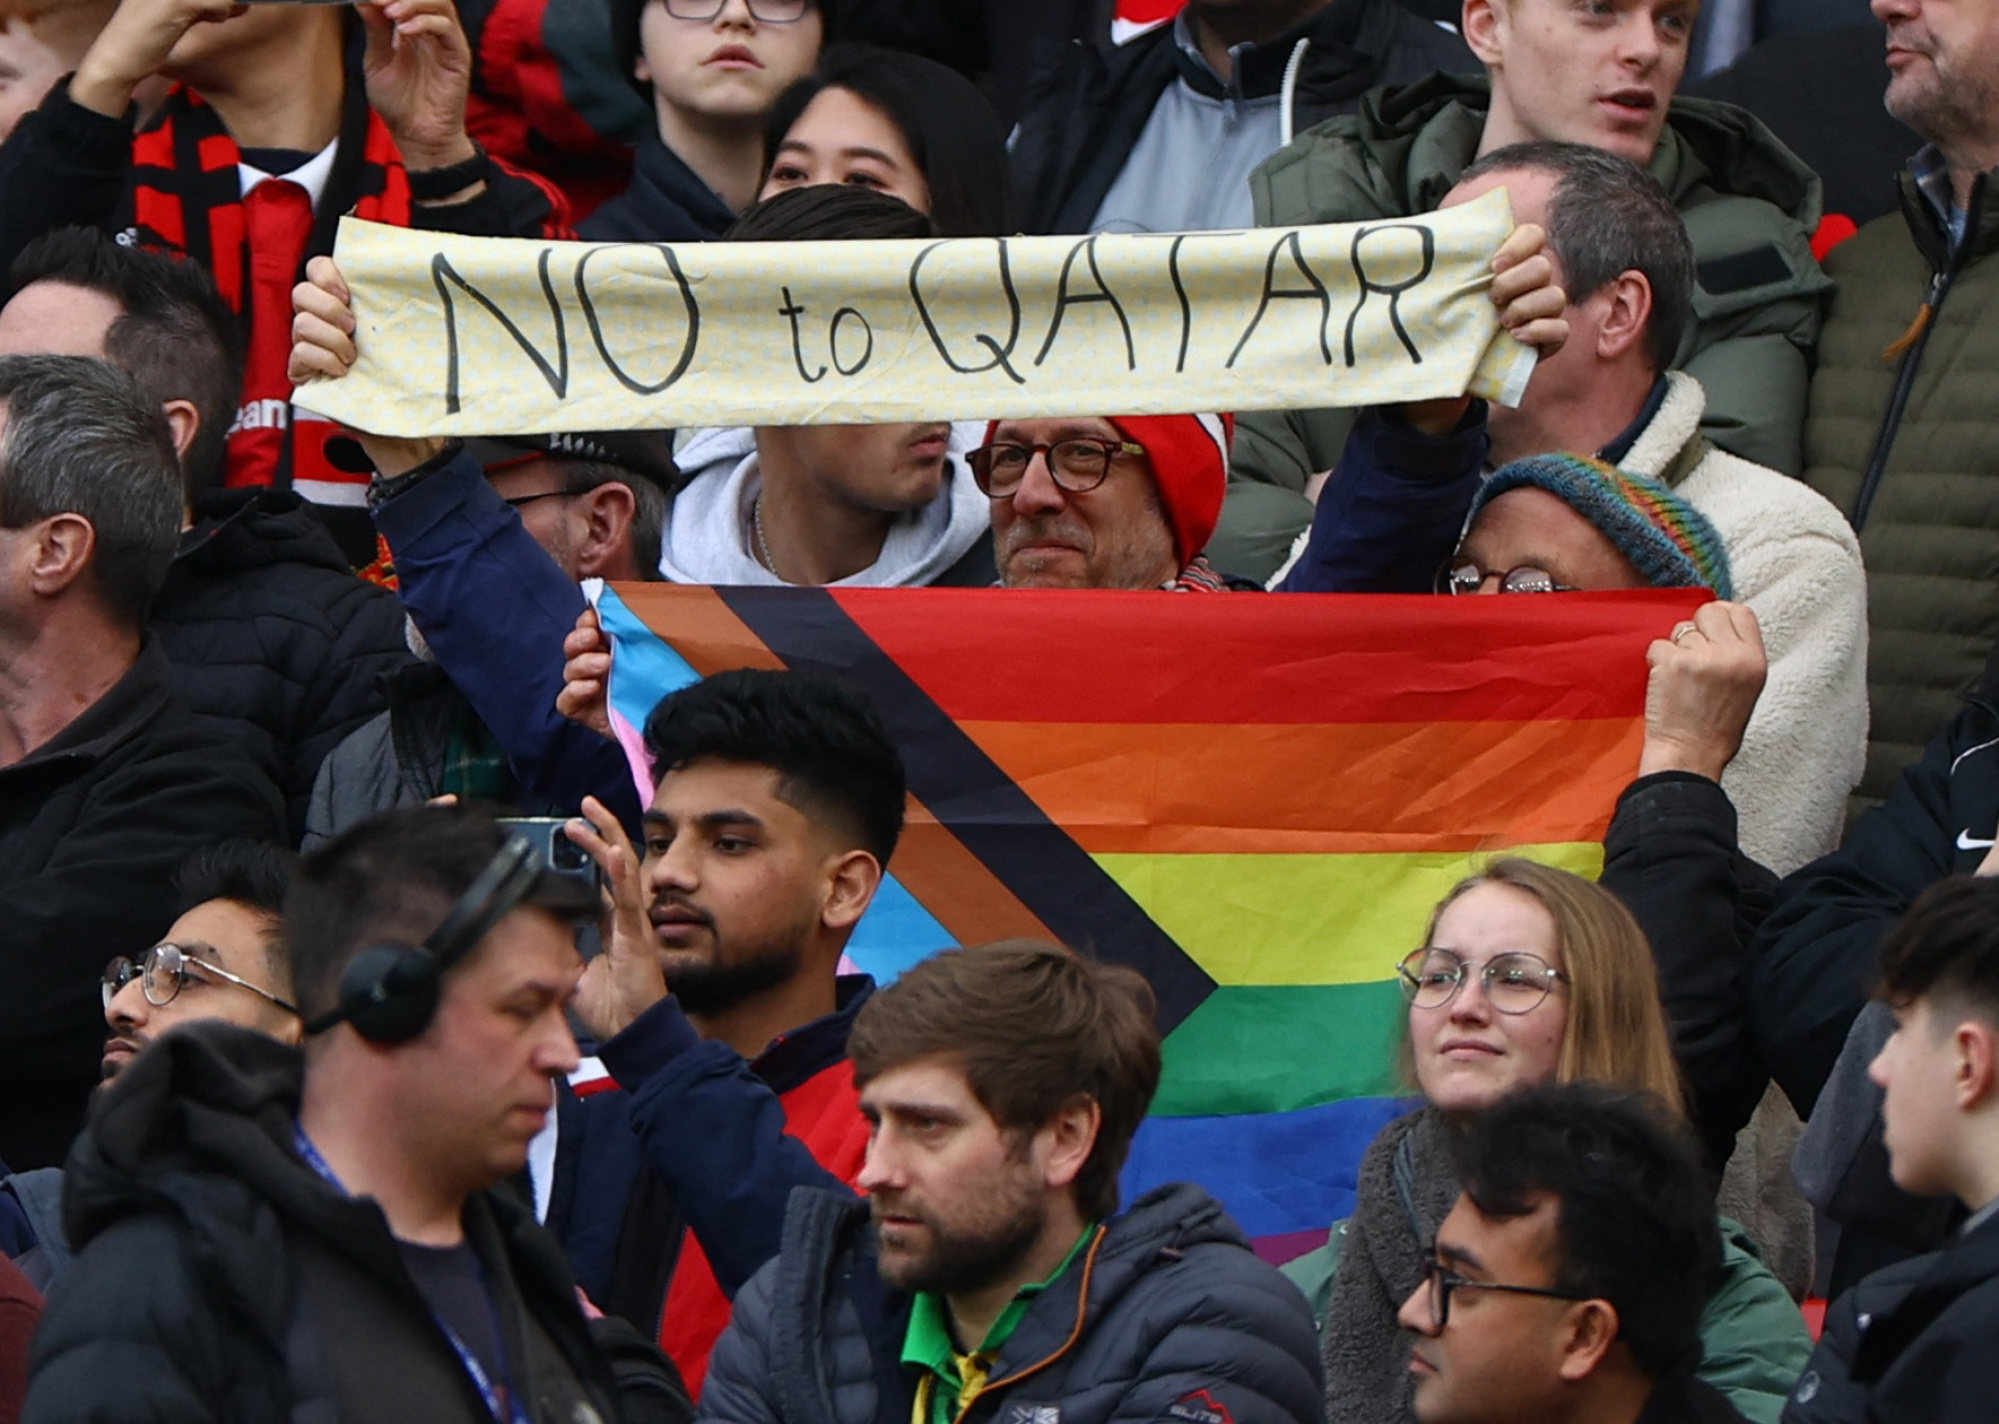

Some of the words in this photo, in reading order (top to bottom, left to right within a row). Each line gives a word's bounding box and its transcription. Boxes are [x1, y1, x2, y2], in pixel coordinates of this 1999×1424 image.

[431, 243, 700, 415] NO
[779, 286, 873, 383] to
[909, 224, 1435, 384] QATAR
